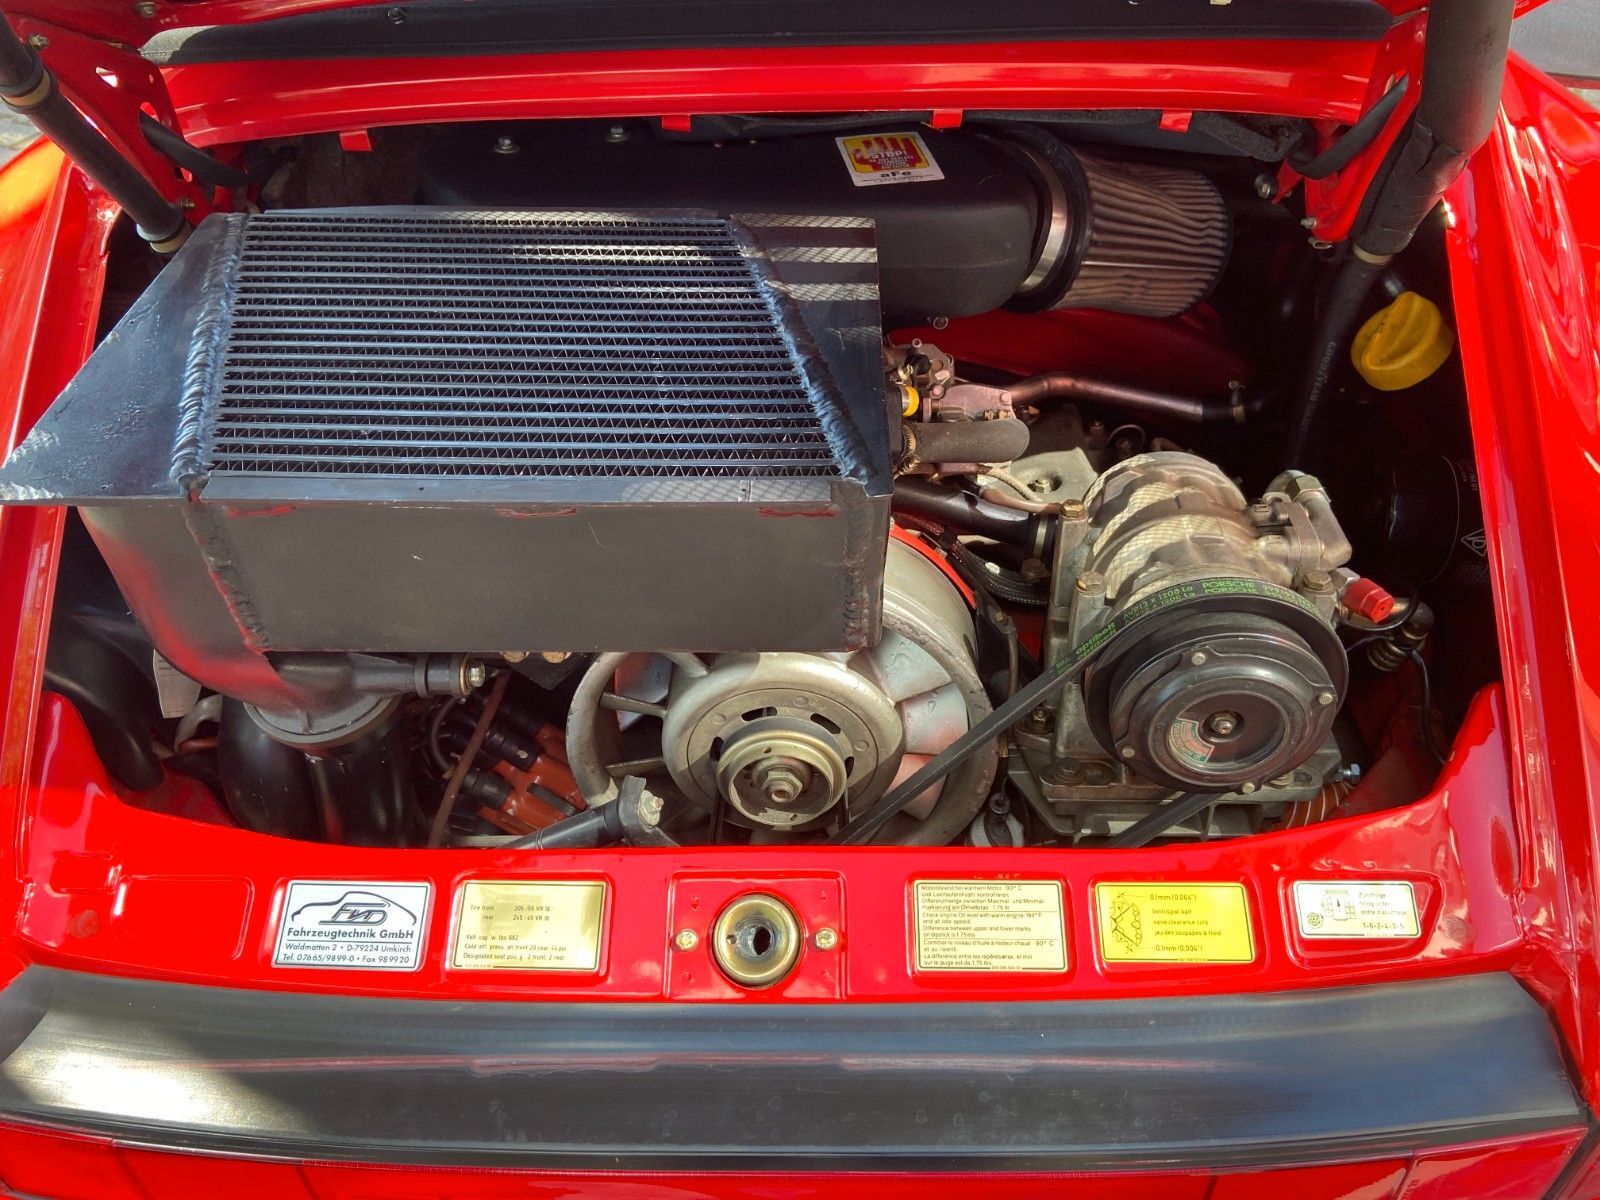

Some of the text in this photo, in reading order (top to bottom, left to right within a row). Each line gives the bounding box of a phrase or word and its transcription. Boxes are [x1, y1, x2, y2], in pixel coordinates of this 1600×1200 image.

[871, 148, 908, 159] STOP!
[1202, 581, 1256, 589] PORSCHE
[287, 927, 415, 940] Fahrzeugtechnik GmbH
[285, 943, 412, 953] Waldmatten 2 D-79224 Umkirch
[283, 953, 295, 961] Tel.
[362, 955, 376, 964] Fax
[463, 952, 493, 960] Designated
